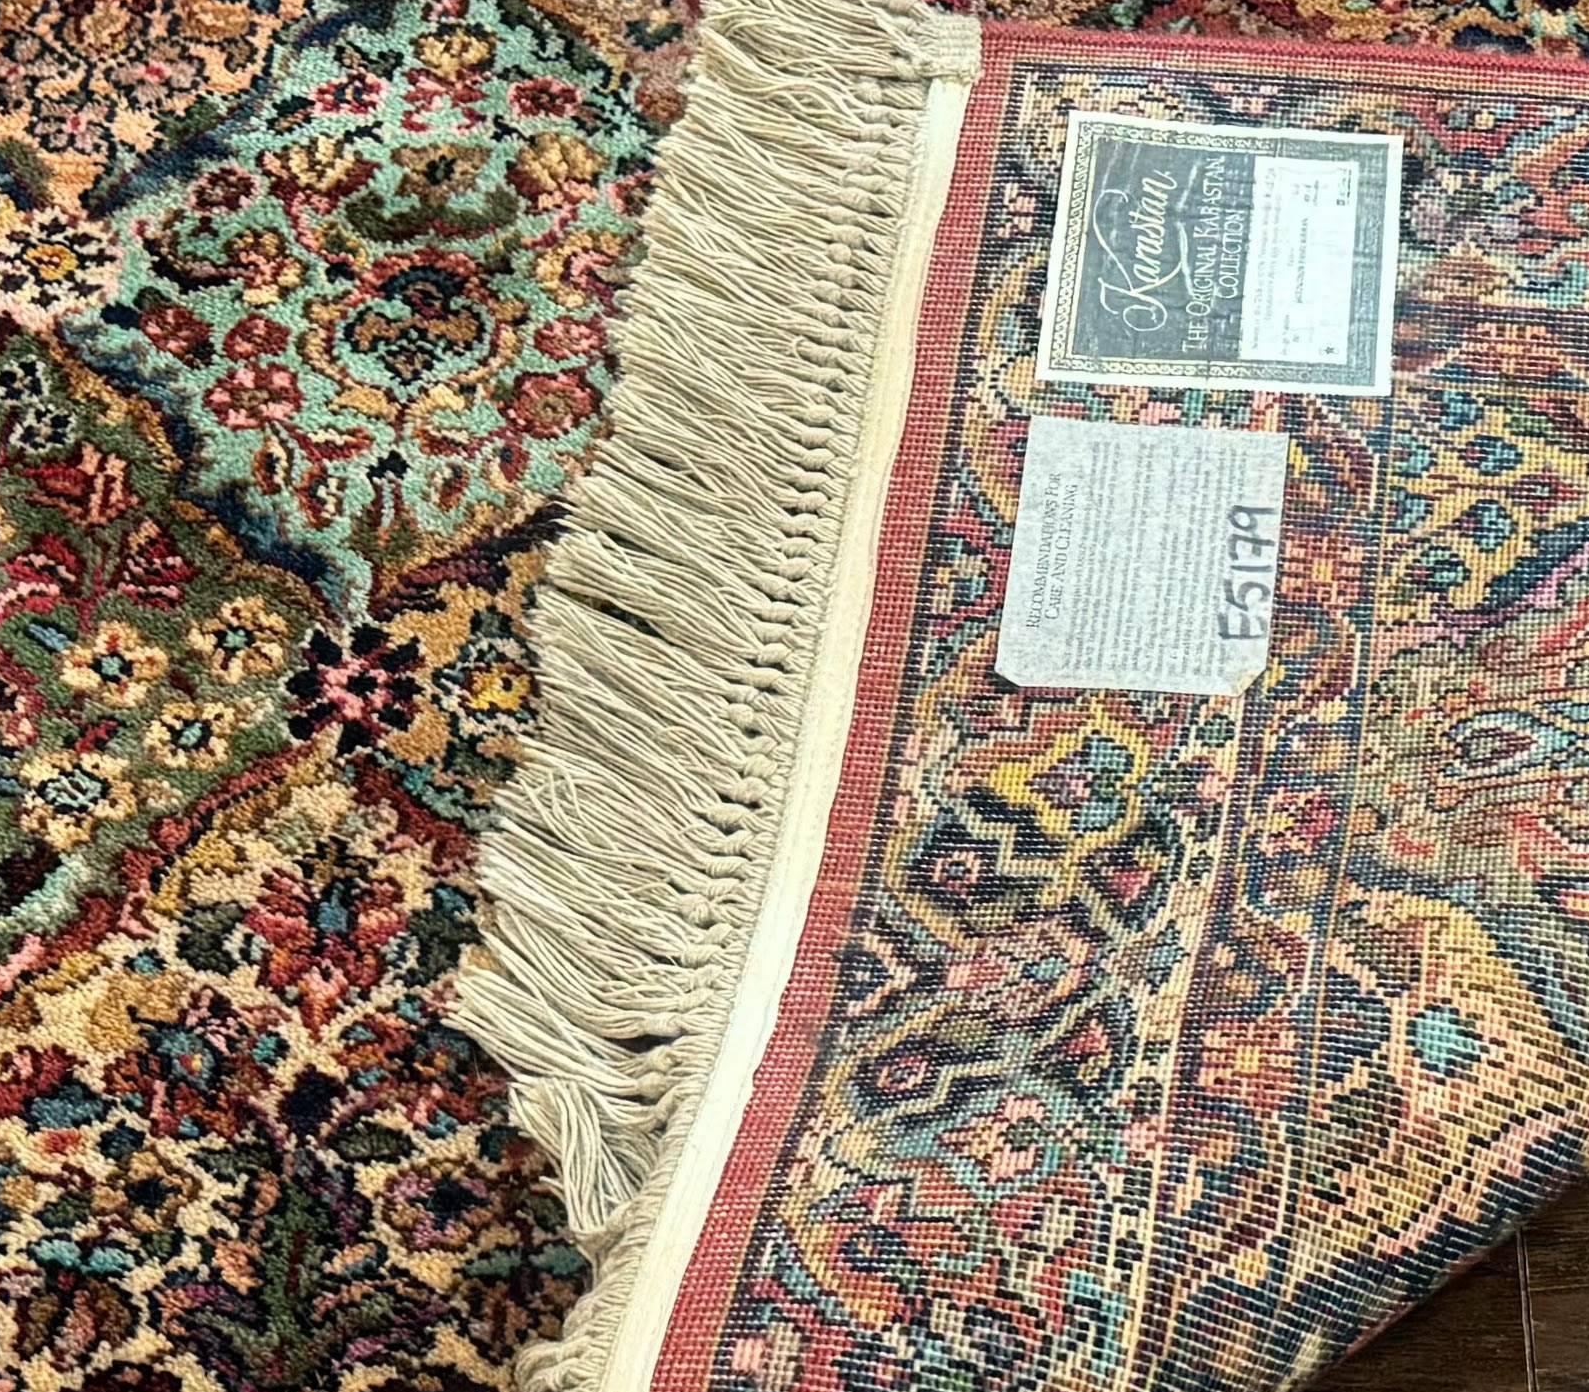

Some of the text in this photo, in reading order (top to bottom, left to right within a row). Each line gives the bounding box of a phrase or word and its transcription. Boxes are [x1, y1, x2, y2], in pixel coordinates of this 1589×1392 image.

[1182, 155, 1225, 353] THE ORIGINAL KARASTAN
[1218, 209, 1246, 299] COLLECTION
[1026, 472, 1062, 628] RECOMMENDATIONS FOR
[1044, 484, 1078, 620] CARE AND CLEANING
